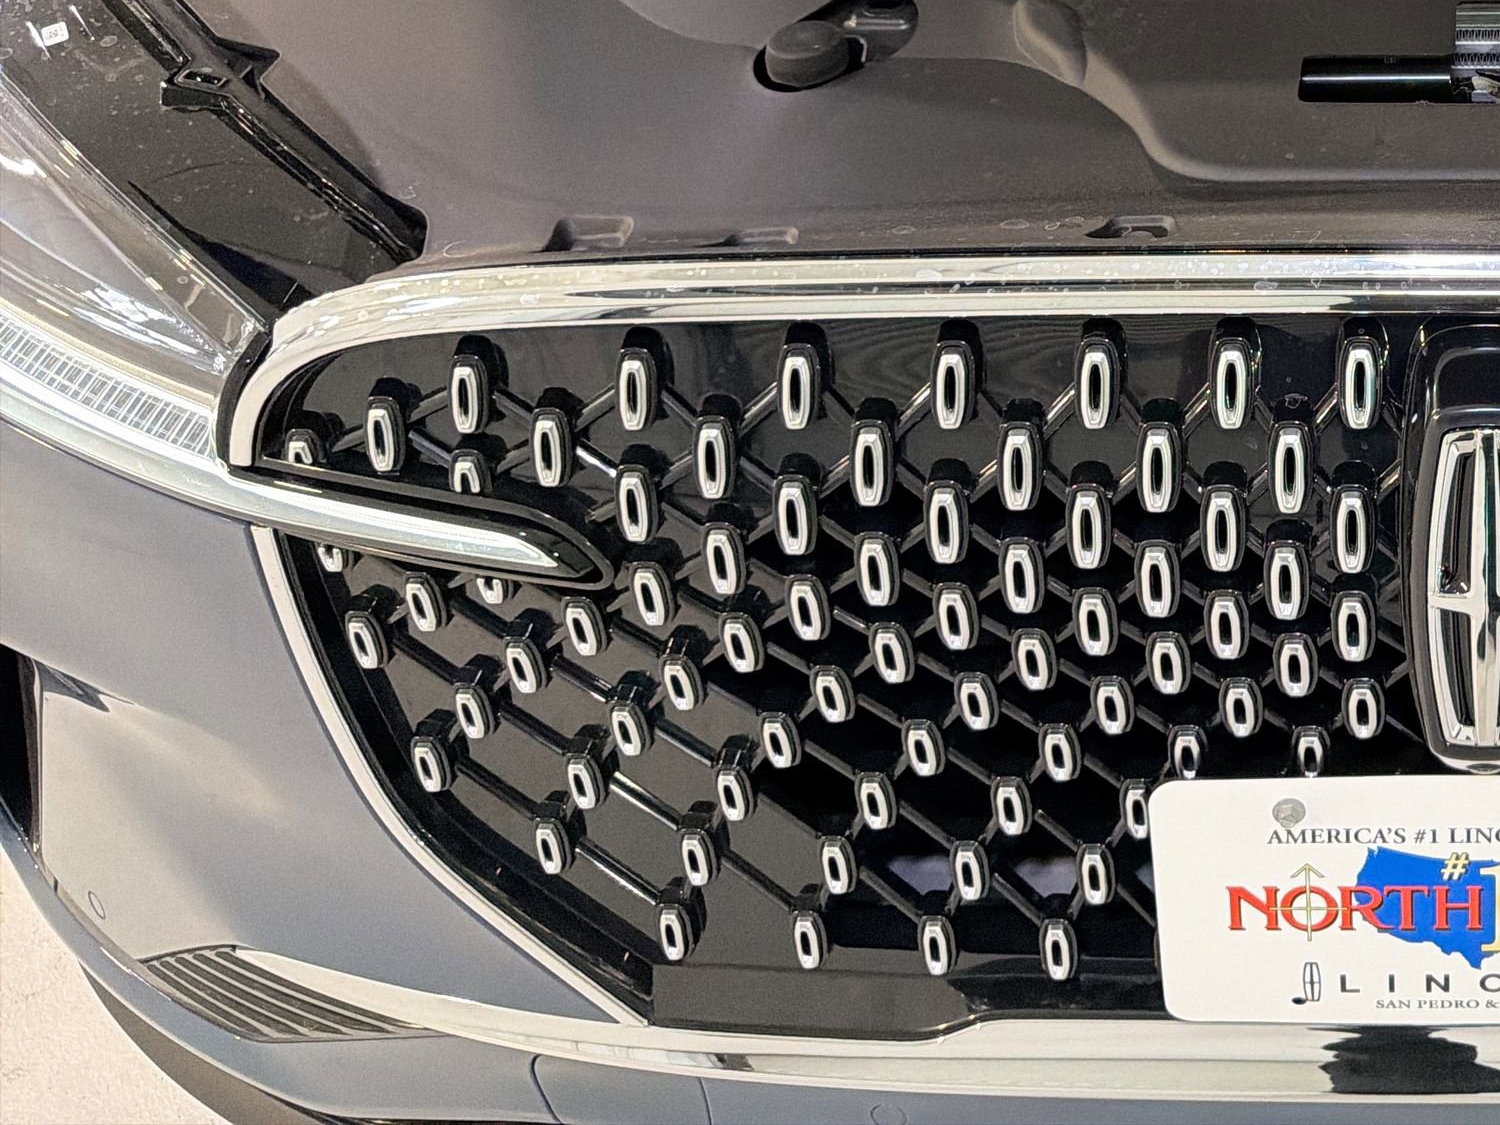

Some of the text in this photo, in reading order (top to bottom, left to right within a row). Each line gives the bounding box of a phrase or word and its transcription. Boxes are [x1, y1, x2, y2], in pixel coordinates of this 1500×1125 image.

[1267, 827, 1406, 845] AMERICA'S
[1414, 827, 1439, 844] #1
[1226, 885, 1485, 932] NORTH
[1375, 999, 1410, 1009] SAN
[1417, 999, 1480, 1009] PEDRO
[1485, 999, 1500, 1009] &
